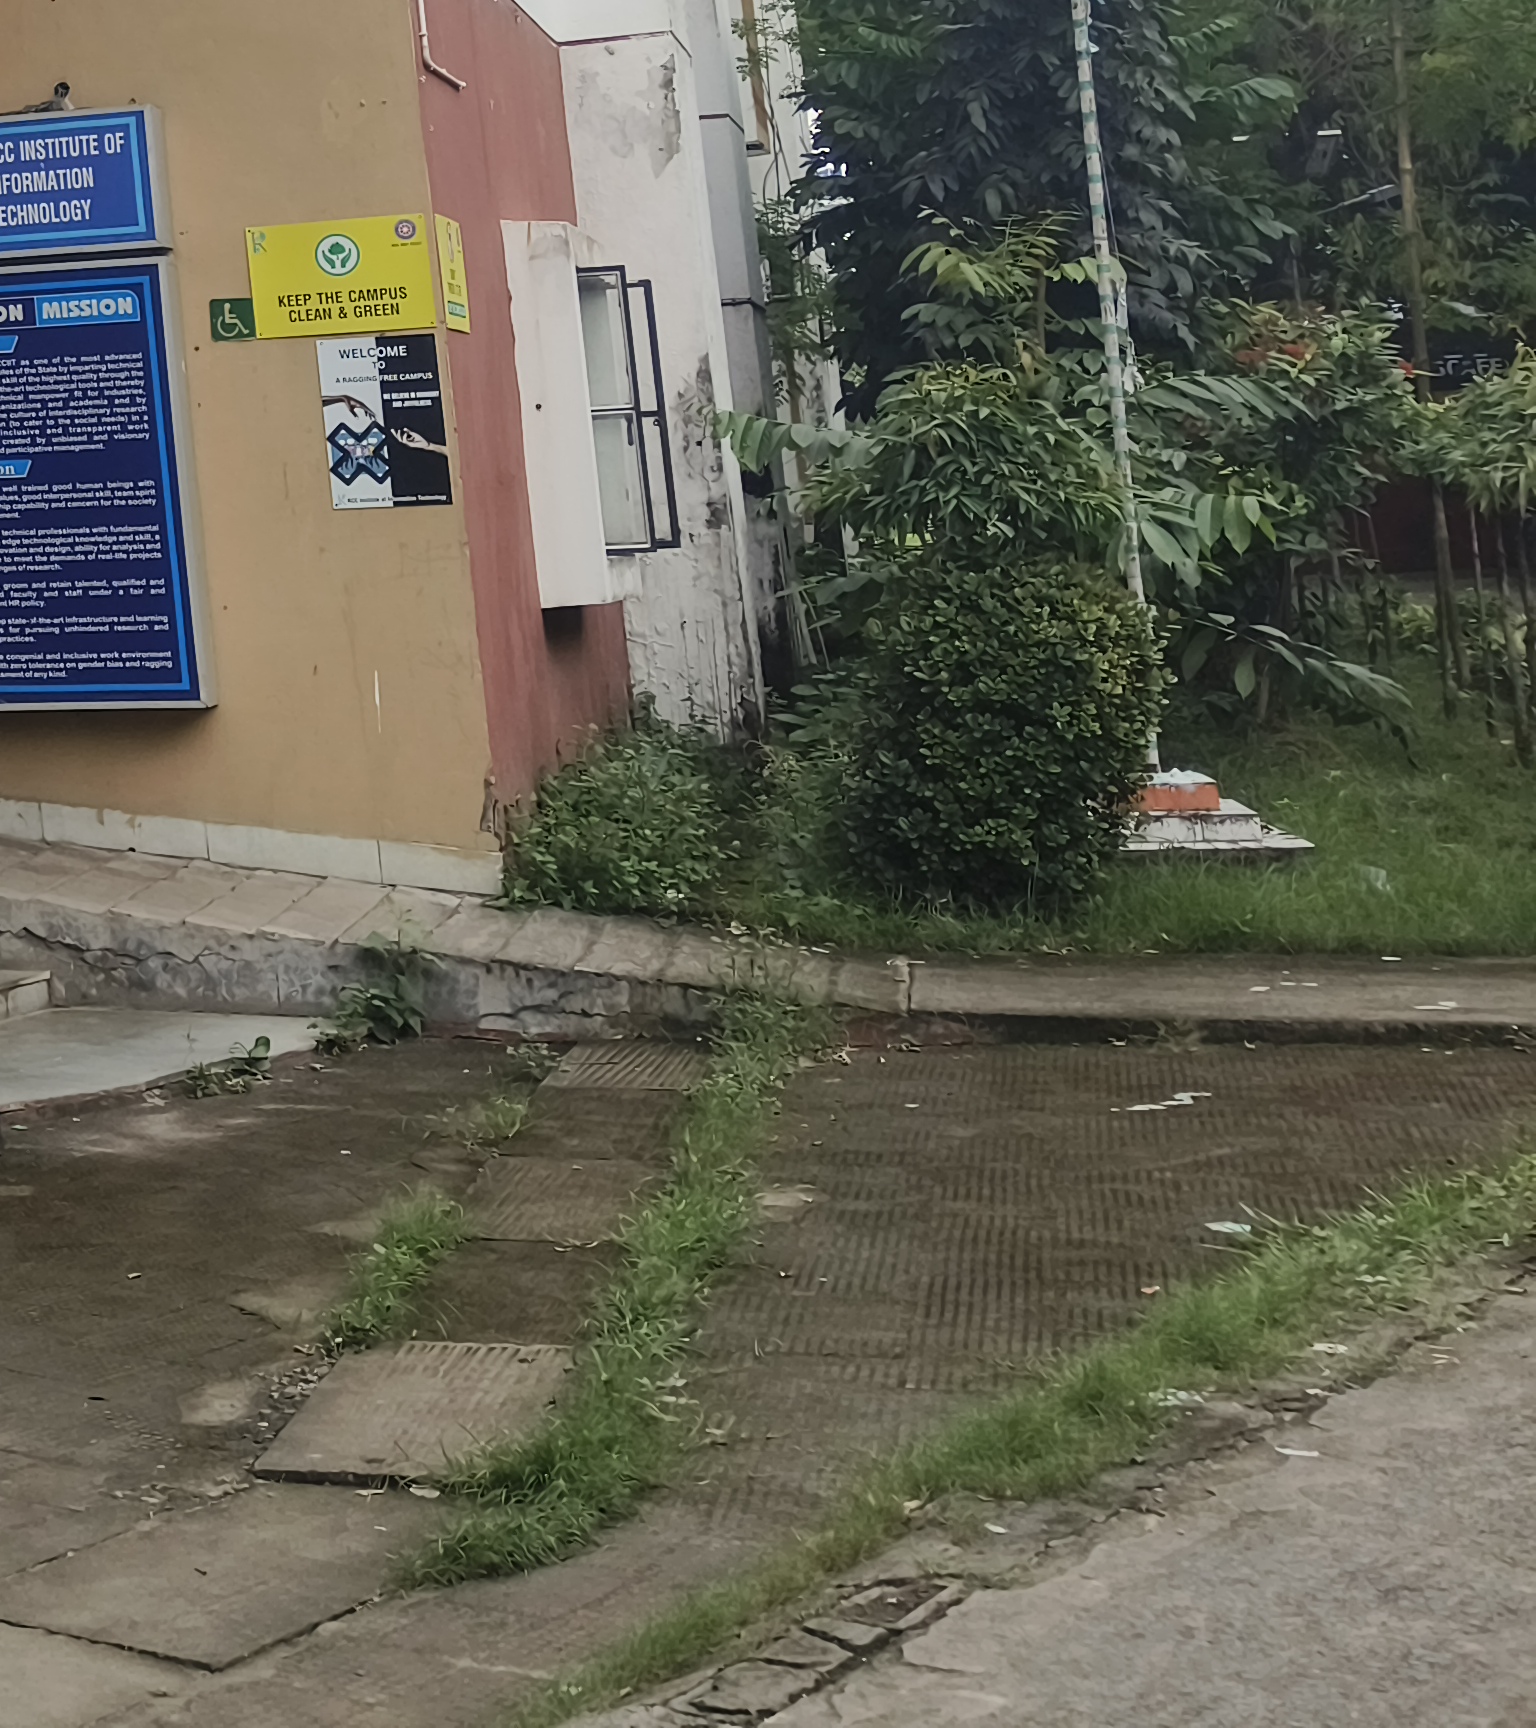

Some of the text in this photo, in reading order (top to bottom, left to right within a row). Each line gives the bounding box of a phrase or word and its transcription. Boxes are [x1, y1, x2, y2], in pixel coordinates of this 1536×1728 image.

[19, 134, 99, 161] INSTITUTE
[104, 132, 124, 154] OF
[278, 286, 408, 308] KEEP THE CAMPUS
[42, 297, 133, 320] MISSION
[289, 303, 400, 323] CLEAN & GREEN
[338, 345, 408, 359] WELCOME
[372, 360, 386, 369] TO
[379, 373, 398, 382] FREE
[399, 372, 433, 381] CAMPUS
[0, 427, 39, 436] inclusive
[68, 423, 120, 434] transparent
